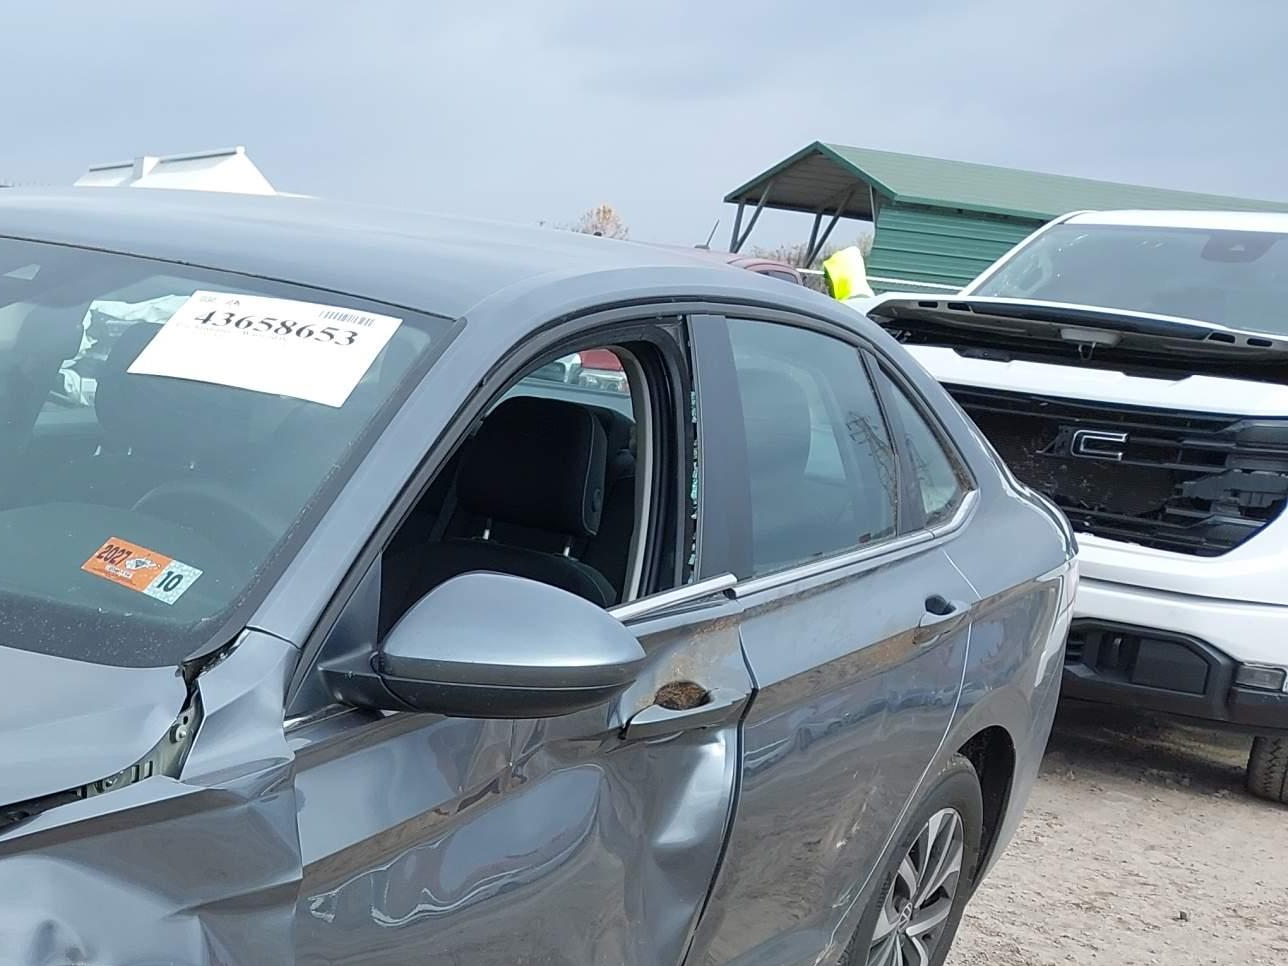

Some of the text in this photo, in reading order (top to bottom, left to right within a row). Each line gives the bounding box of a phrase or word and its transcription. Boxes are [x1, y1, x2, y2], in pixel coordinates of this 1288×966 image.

[194, 310, 359, 346] 43658653
[96, 544, 133, 566] 2027
[156, 570, 184, 593] 10
